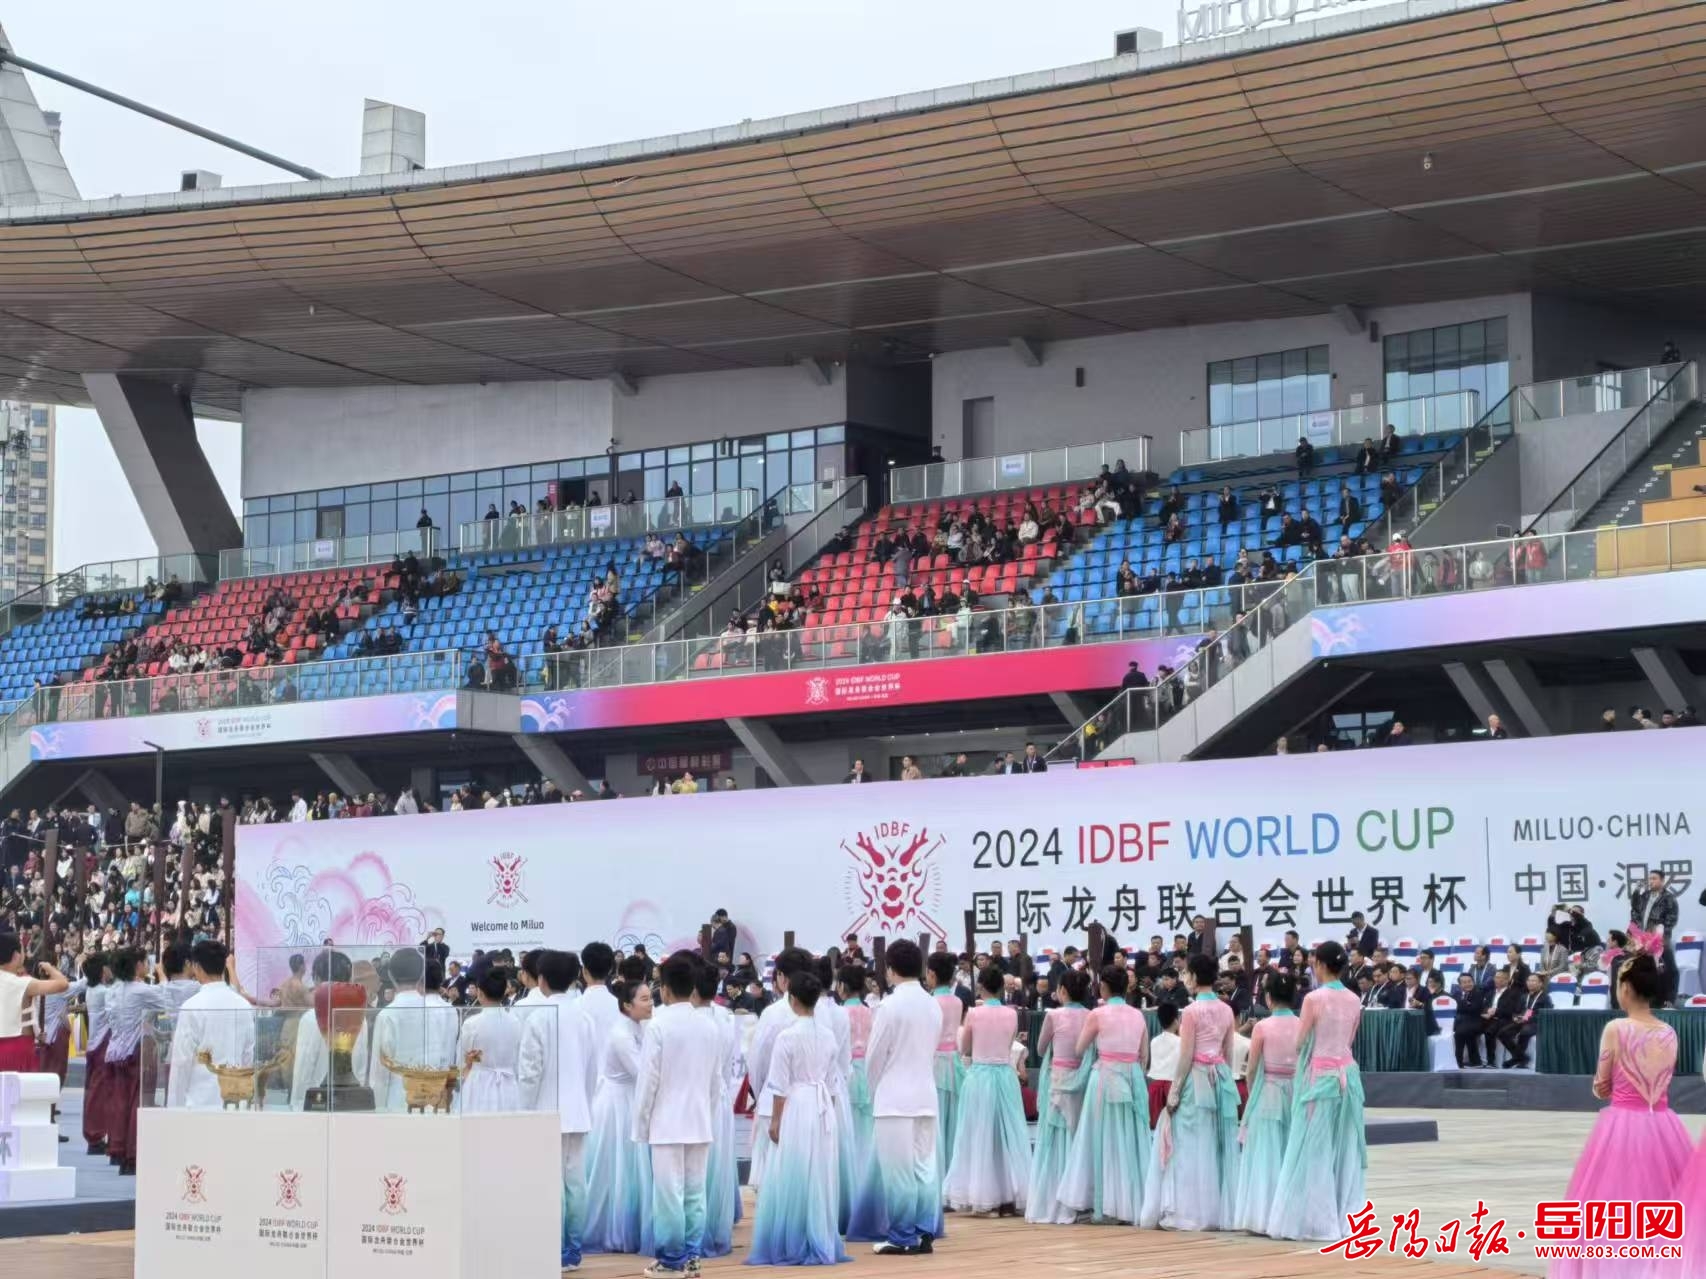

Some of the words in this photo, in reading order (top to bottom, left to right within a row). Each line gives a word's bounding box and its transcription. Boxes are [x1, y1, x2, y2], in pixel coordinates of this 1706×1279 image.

[874, 821, 910, 840] IDBF
[972, 827, 1063, 869] 2024
[1078, 821, 1171, 864] IDBF
[1185, 812, 1340, 859] WORLD
[1356, 806, 1455, 852] CUP
[971, 871, 1468, 934] 国际龙舟联合会世界杯
[471, 920, 509, 932] Welcome
[510, 920, 519, 931] to
[520, 919, 545, 930] Miluo
